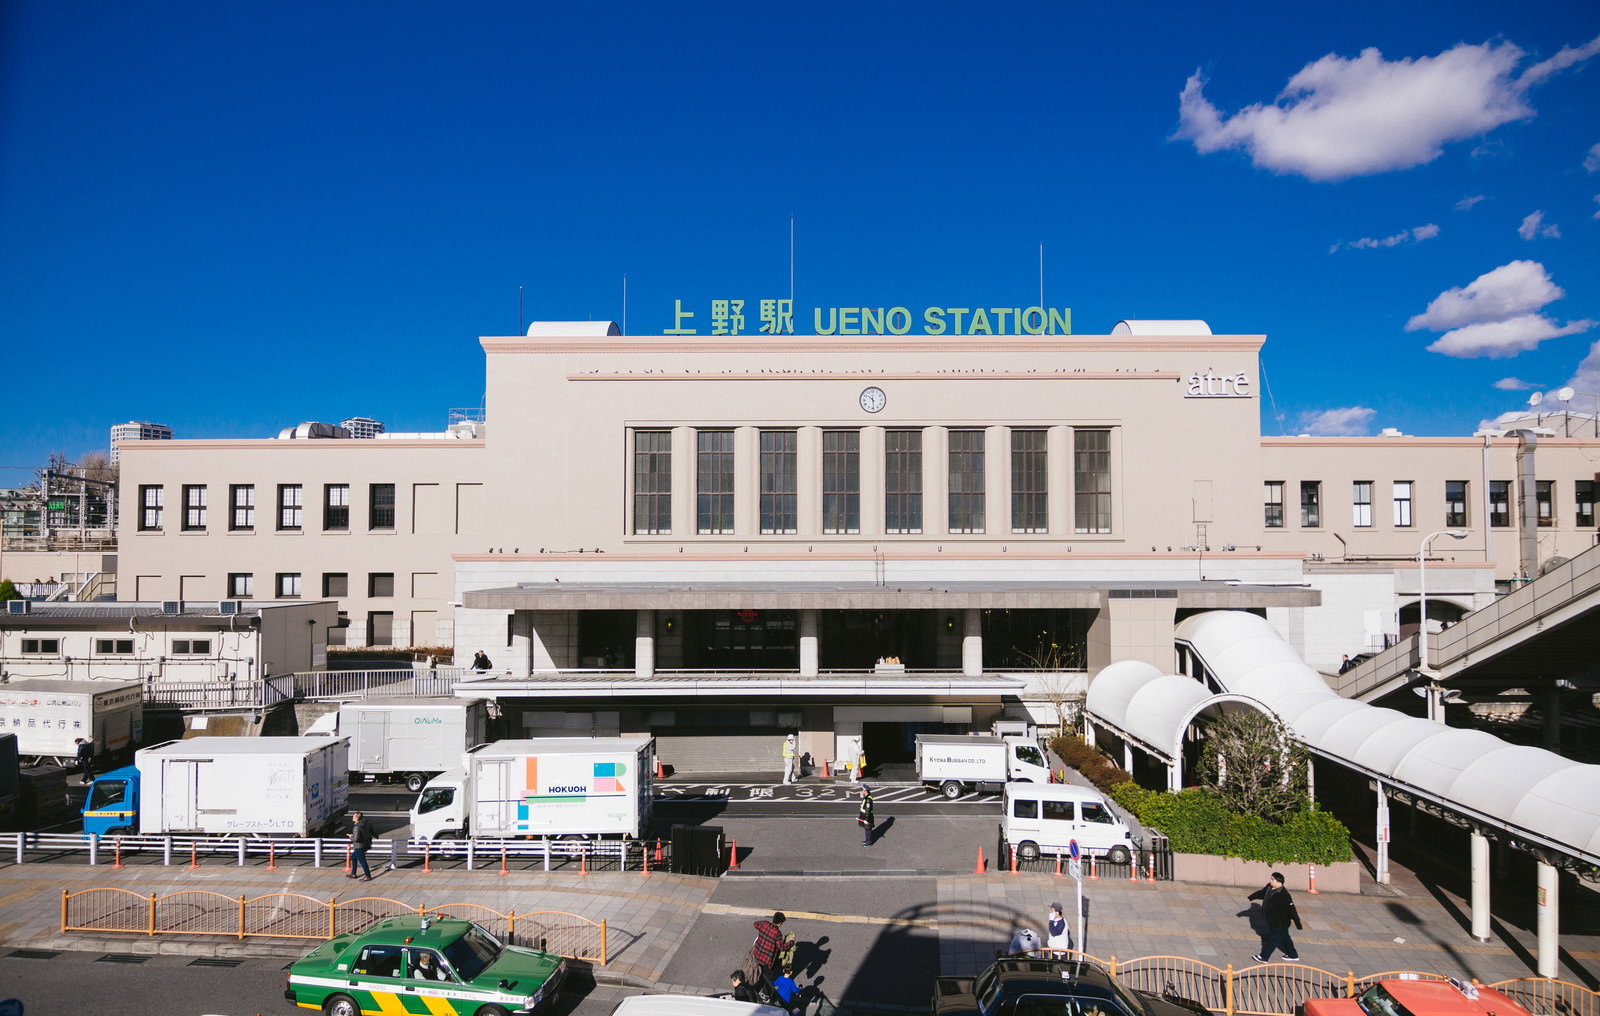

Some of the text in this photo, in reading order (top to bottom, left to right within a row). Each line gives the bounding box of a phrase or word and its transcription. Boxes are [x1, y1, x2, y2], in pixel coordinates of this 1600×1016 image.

[663, 299, 1072, 336] 上野駅 UENO STATION
[1187, 369, 1250, 395] atré
